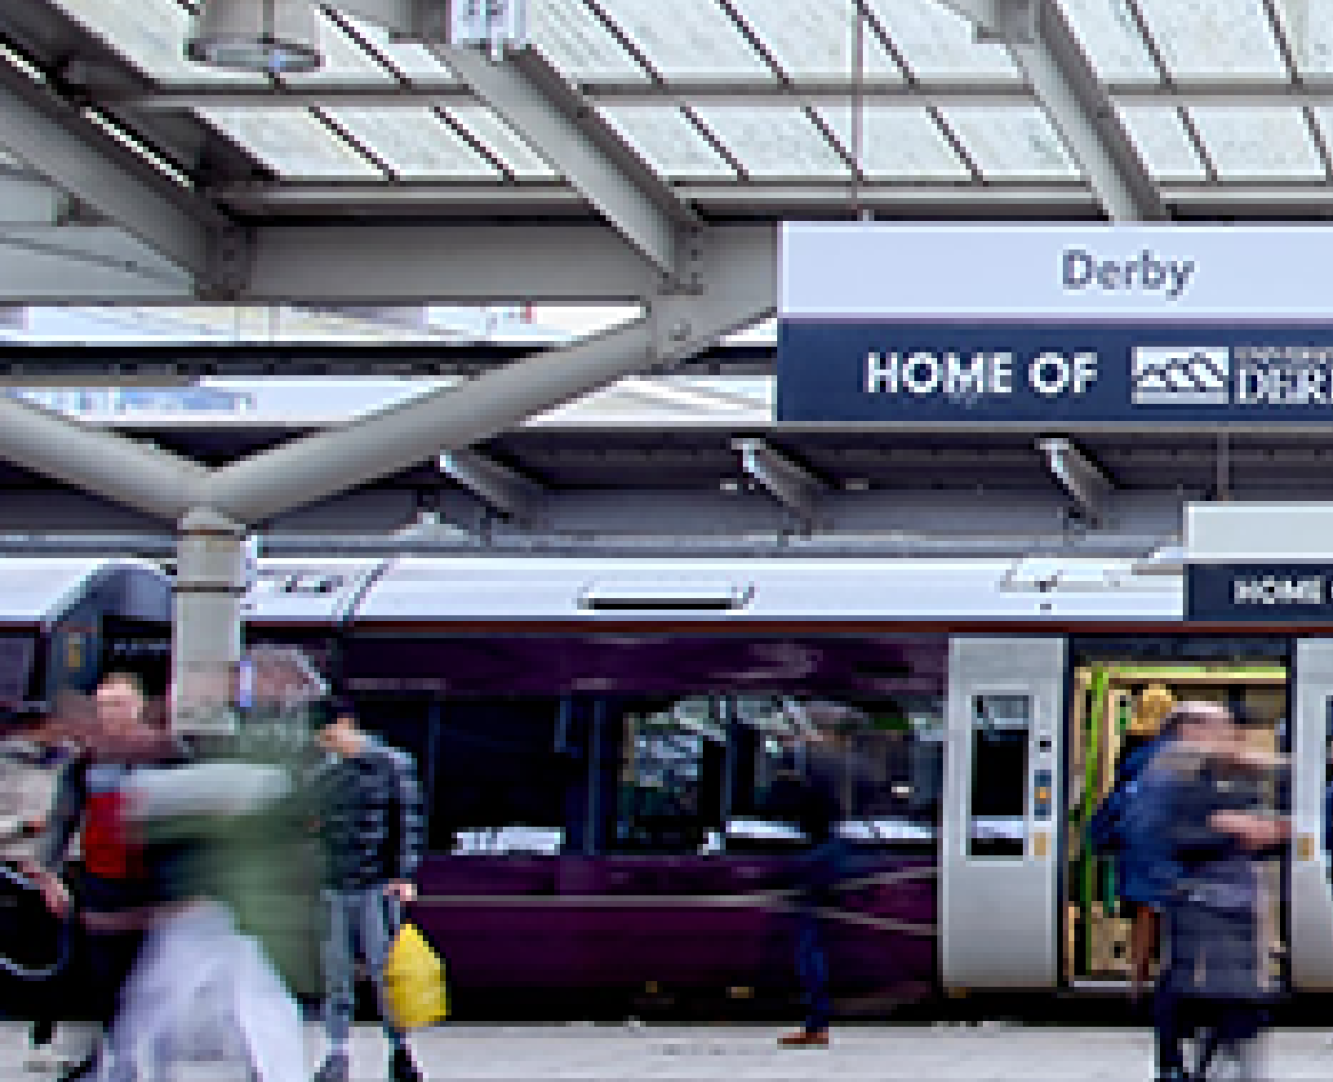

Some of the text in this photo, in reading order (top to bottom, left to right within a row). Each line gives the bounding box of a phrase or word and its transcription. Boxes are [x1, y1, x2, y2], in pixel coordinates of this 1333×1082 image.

[1062, 248, 1194, 301] Derby
[864, 351, 1098, 395] HOME OF
[1233, 579, 1321, 605] HOME
